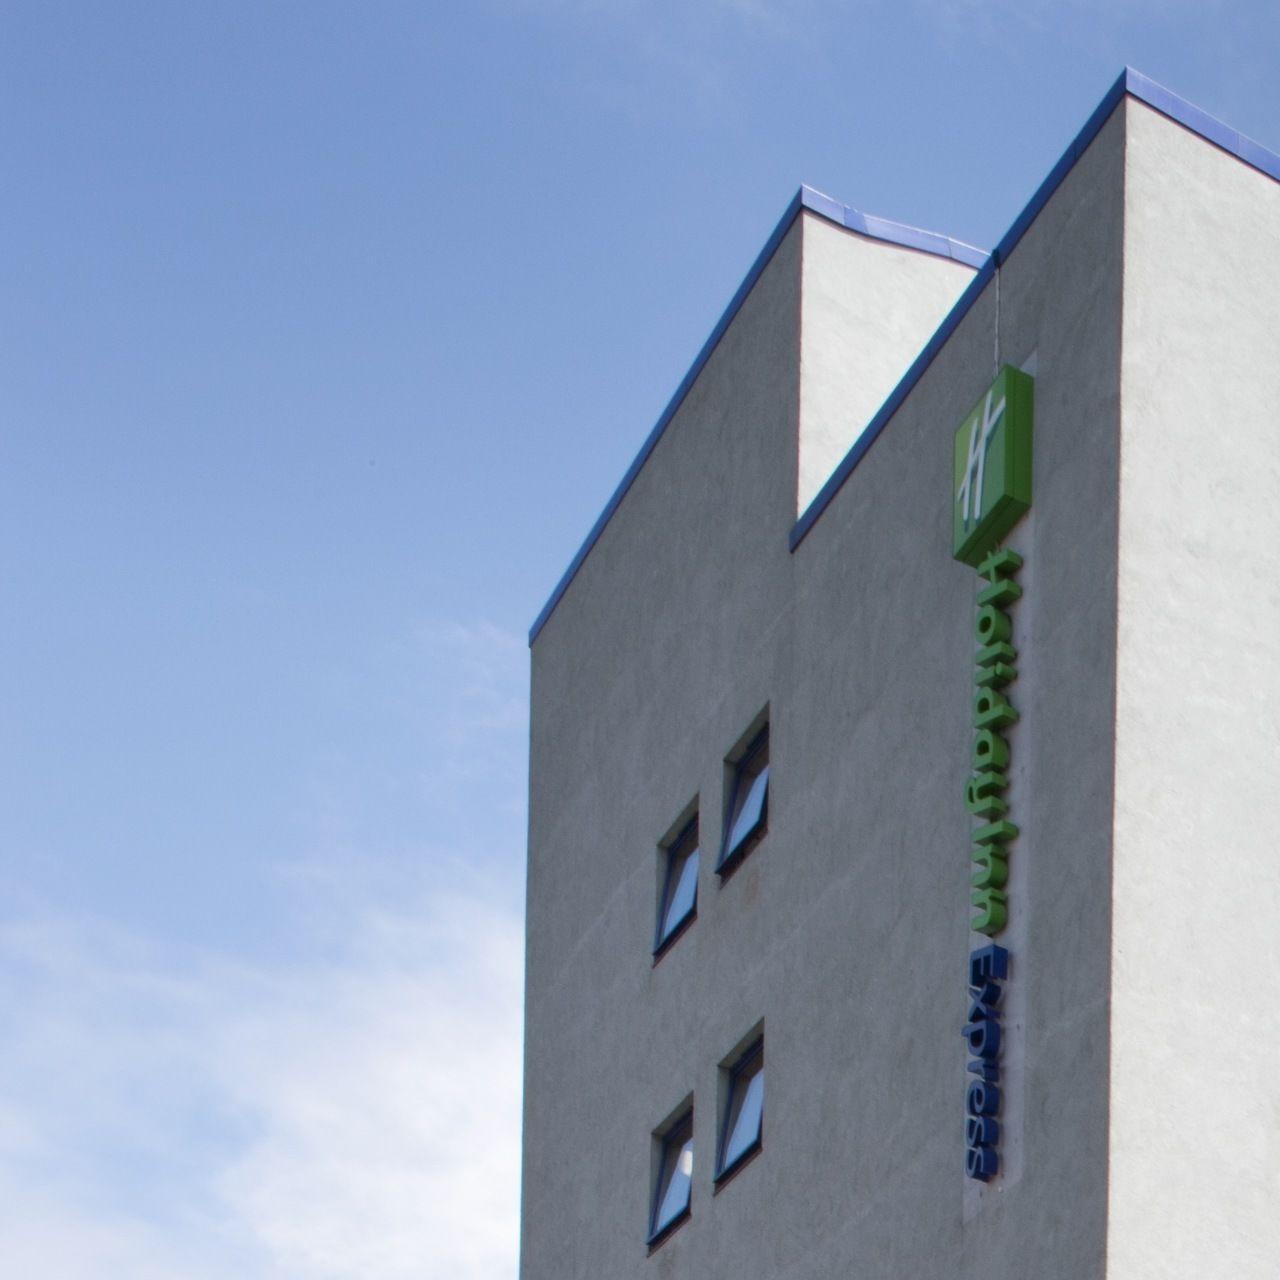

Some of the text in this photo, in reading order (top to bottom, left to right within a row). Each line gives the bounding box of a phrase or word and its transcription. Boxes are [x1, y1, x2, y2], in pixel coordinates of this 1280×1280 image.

[964, 549, 1023, 935] Holiday Inn
[961, 944, 1009, 1183] Express
